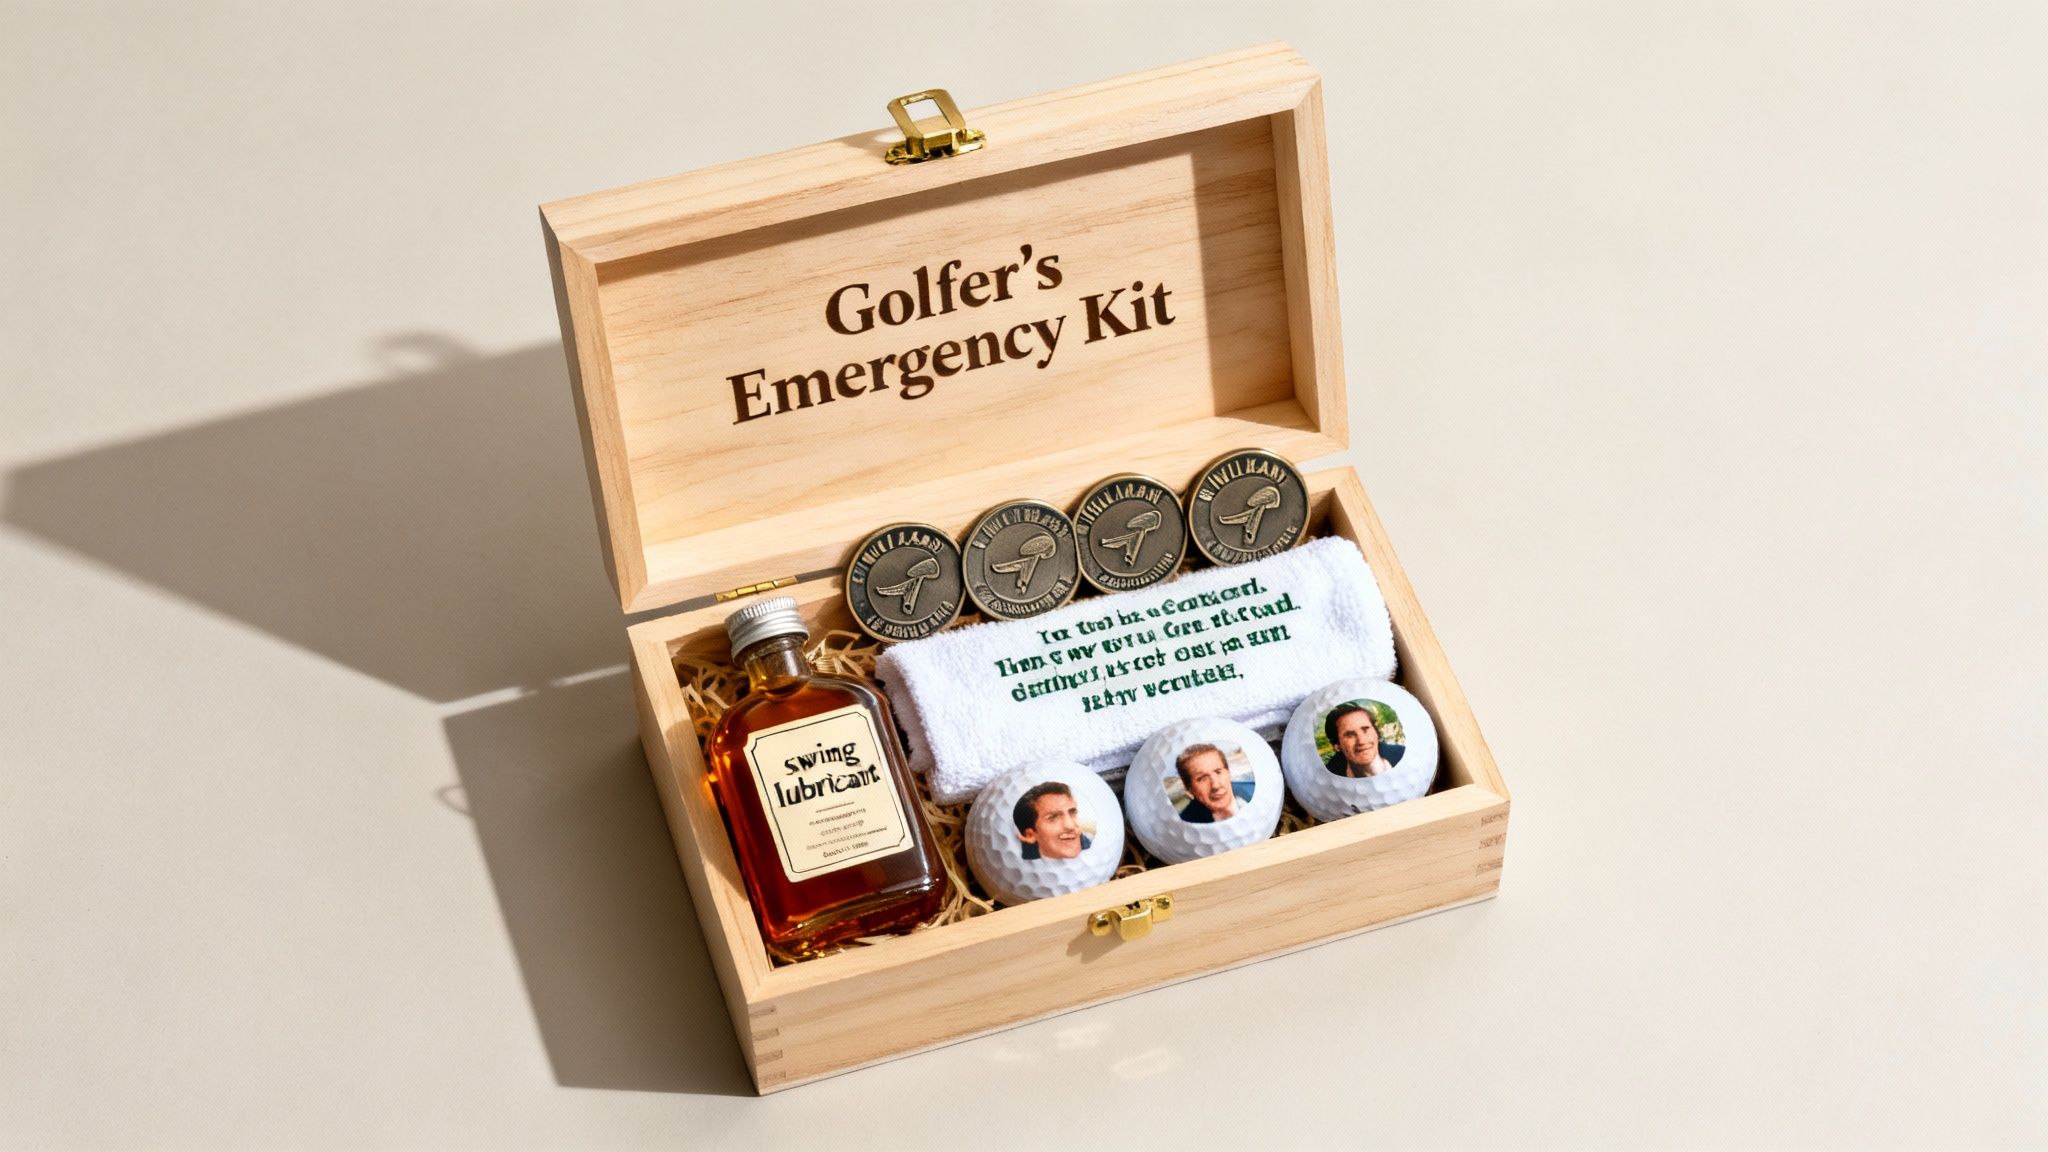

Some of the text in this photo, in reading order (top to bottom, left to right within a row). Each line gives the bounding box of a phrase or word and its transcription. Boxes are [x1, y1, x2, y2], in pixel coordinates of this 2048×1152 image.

[825, 243, 1063, 336] Golfer's
[725, 280, 1176, 426] Emergency Kit
[784, 742, 860, 776] swing
